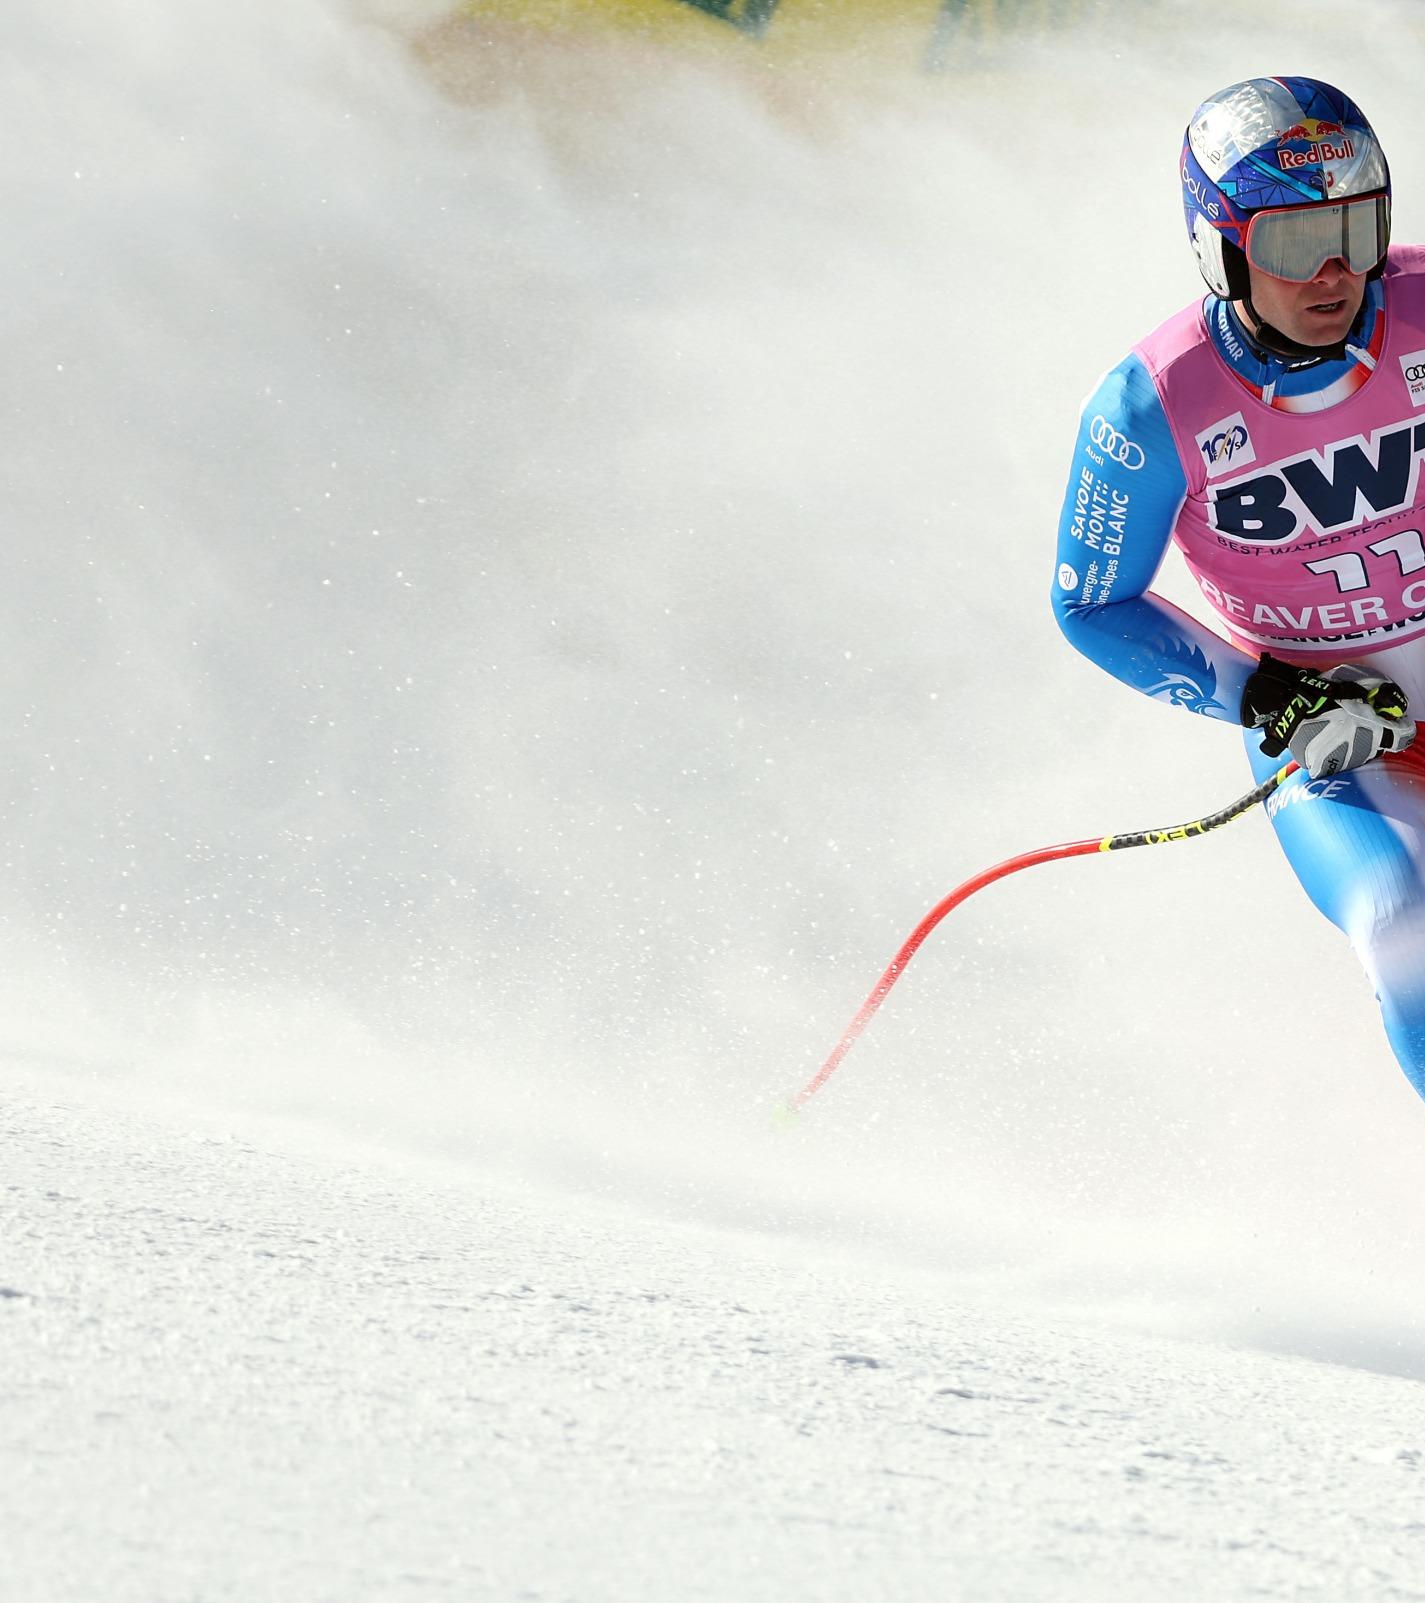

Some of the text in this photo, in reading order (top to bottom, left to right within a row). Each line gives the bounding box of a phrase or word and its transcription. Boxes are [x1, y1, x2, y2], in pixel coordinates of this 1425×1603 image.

[1278, 139, 1355, 170] Red Bull
[1217, 312, 1245, 363] COLMAR
[1085, 444, 1105, 467] Audi
[1071, 466, 1094, 540] SAVOIE
[1085, 489, 1130, 556] MONT BLANC
[1217, 535, 1265, 556] BEST
[1079, 560, 1099, 606] uvergne-
[1301, 675, 1330, 691] LEKI
[1274, 696, 1305, 739] LEKI
